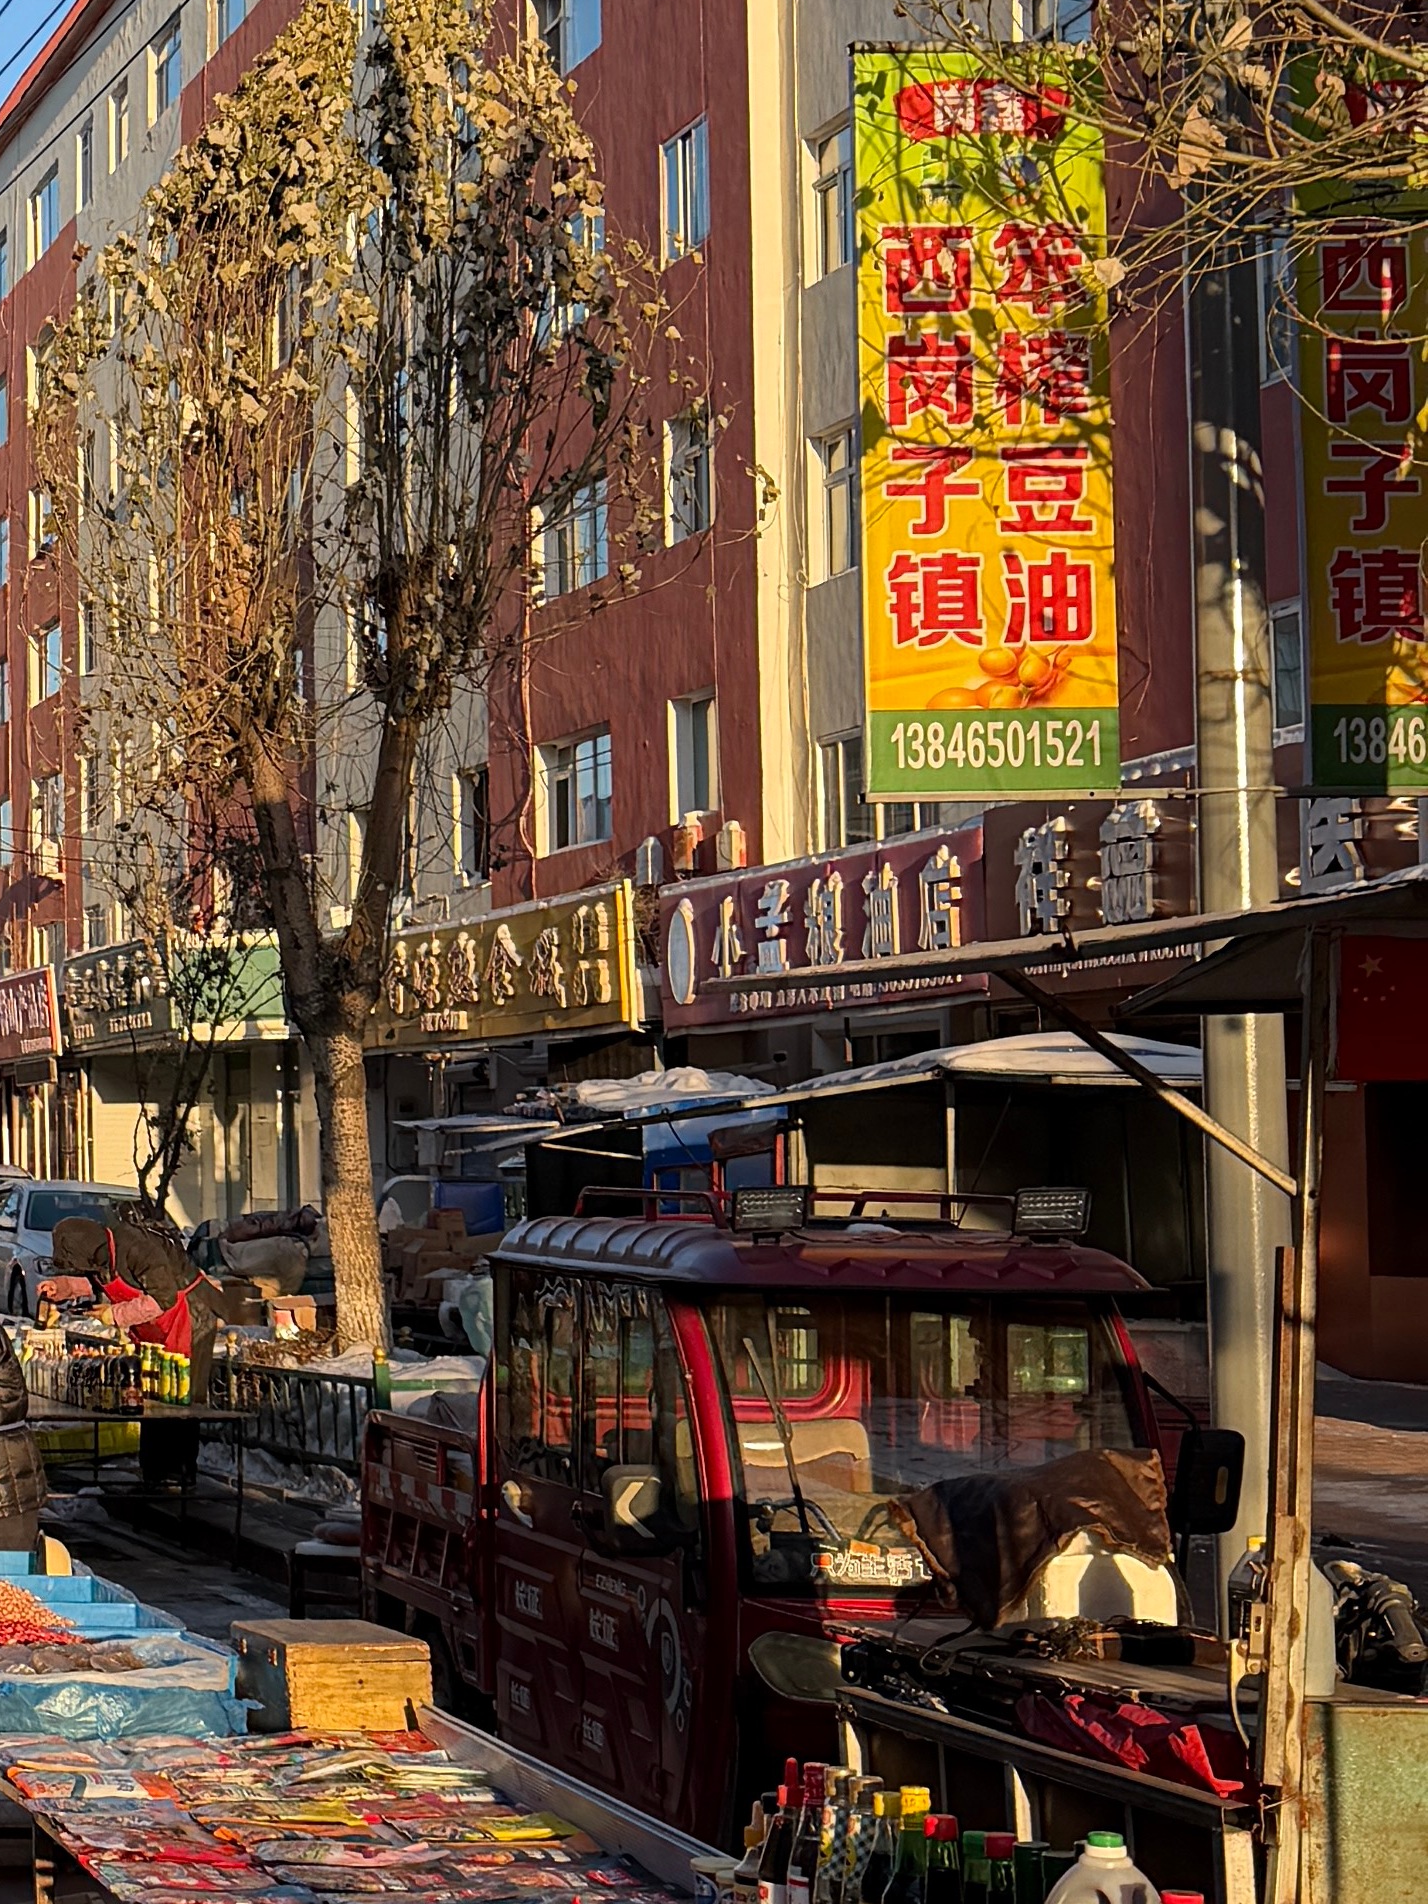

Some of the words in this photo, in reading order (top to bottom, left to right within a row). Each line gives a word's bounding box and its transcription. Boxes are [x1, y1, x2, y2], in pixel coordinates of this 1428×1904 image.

[882, 226, 984, 646] 西岗子镇
[994, 223, 1093, 644] 笨榨豆油
[1321, 226, 1426, 642] 西岗子镇
[892, 720, 1101, 770] 13846501521
